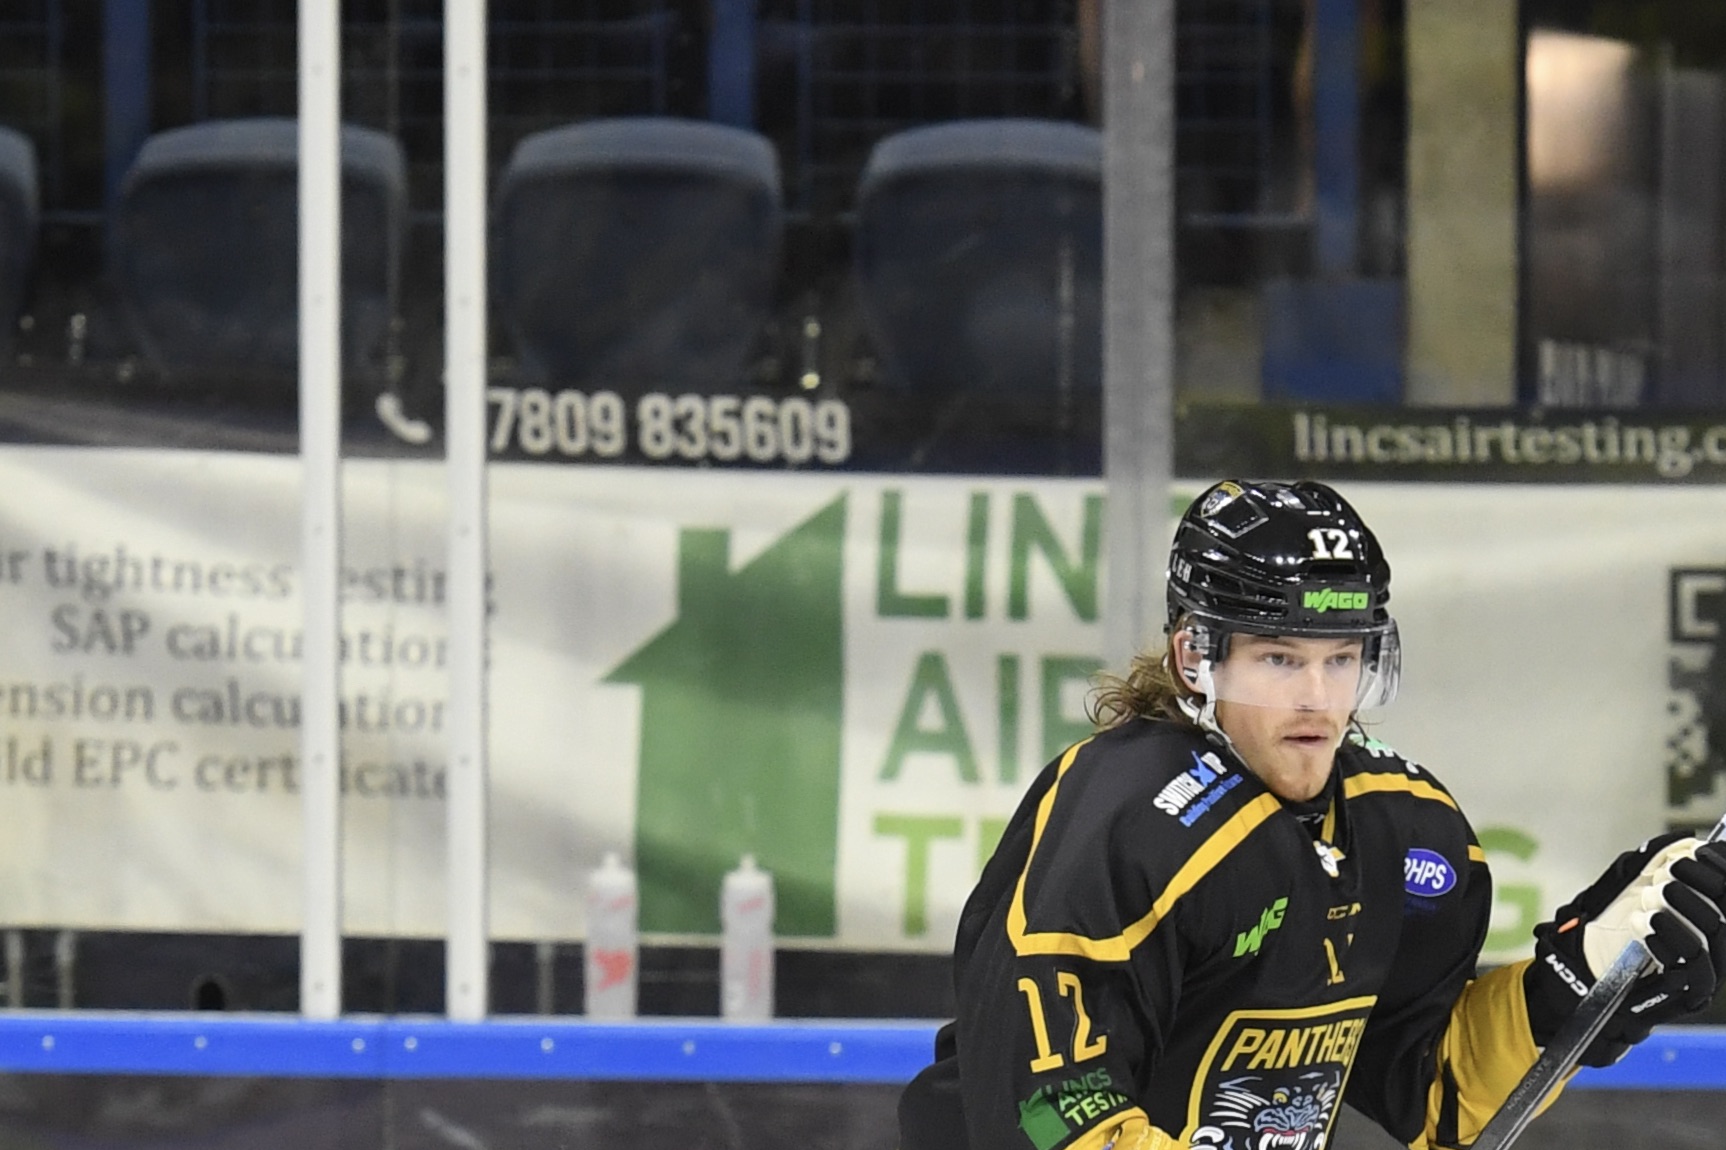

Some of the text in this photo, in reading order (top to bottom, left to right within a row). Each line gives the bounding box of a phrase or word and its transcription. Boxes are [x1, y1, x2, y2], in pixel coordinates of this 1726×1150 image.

[485, 391, 852, 464] 7809 835609
[43, 544, 293, 600] tightness
[876, 490, 1106, 622] LIN
[1308, 529, 1353, 560] 12
[1303, 588, 1369, 613] WAGO
[51, 606, 494, 672] SAP calcution
[172, 678, 448, 733] calcution
[73, 741, 182, 789] EPC
[1018, 971, 1108, 1074] 12
